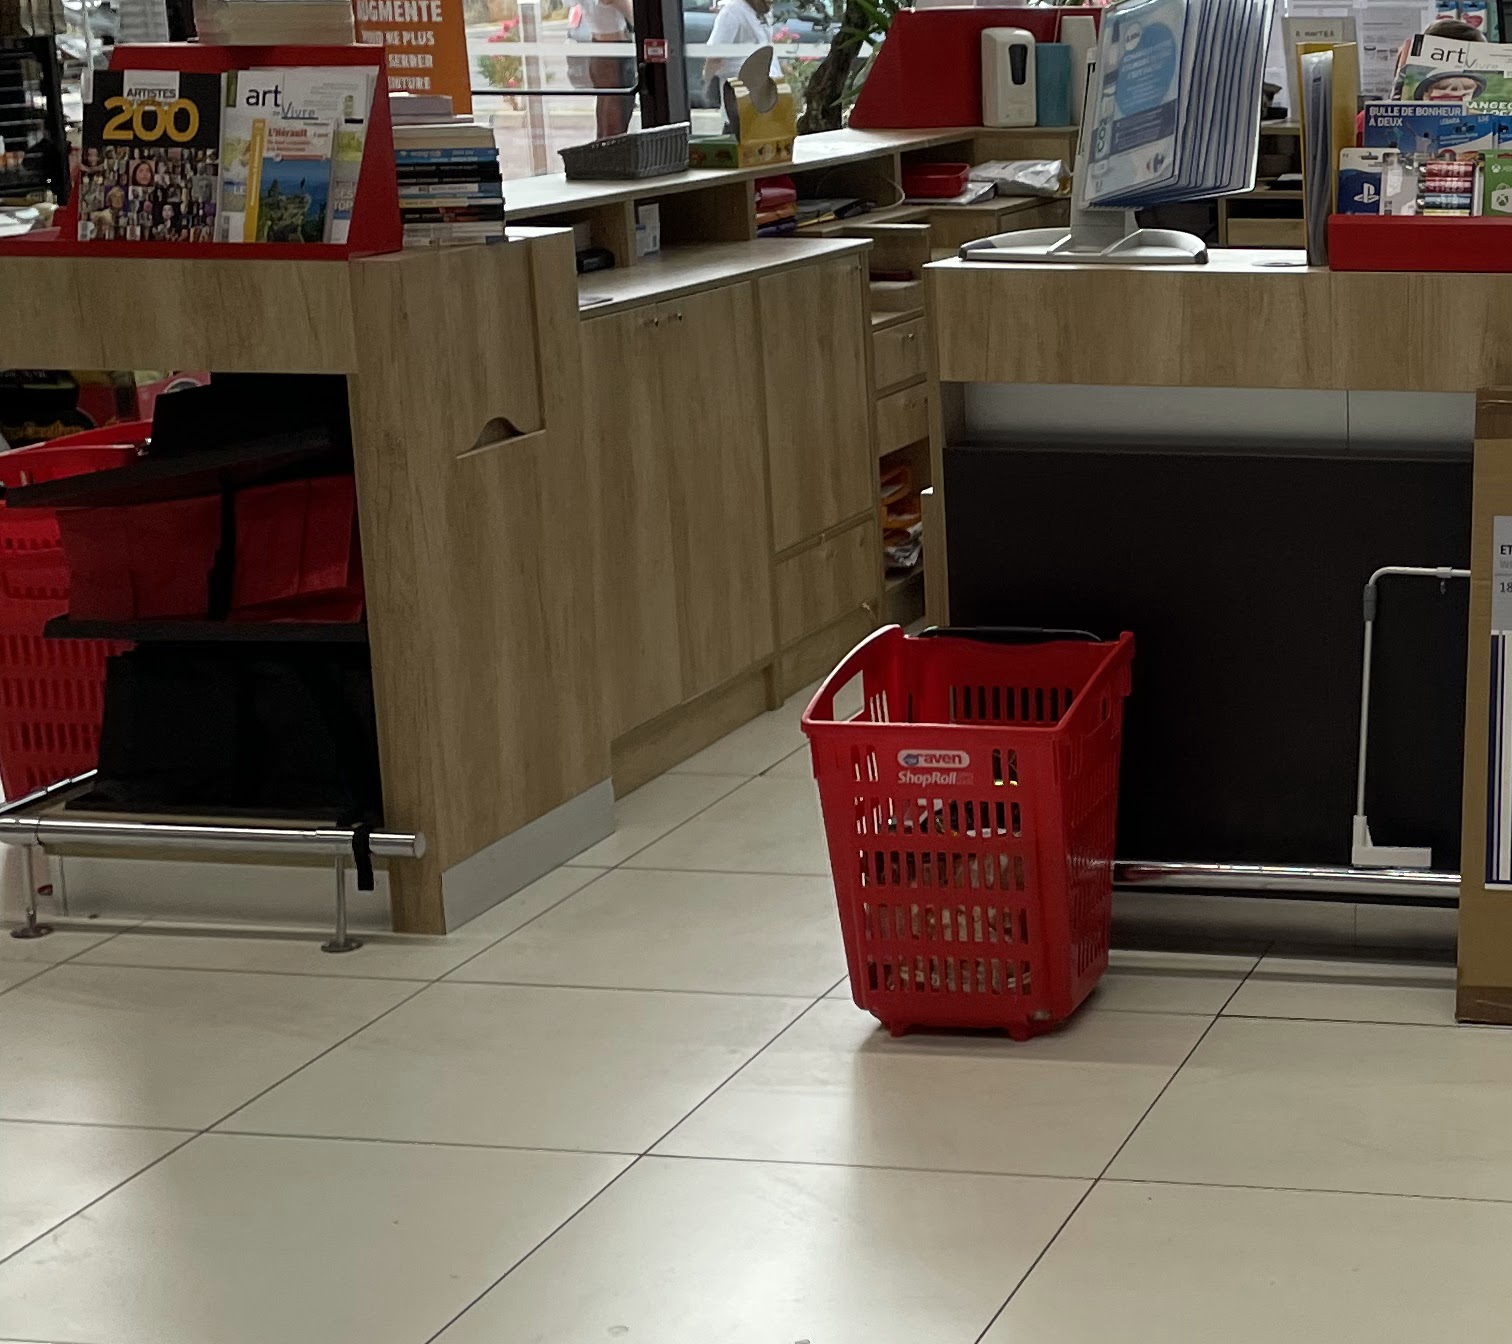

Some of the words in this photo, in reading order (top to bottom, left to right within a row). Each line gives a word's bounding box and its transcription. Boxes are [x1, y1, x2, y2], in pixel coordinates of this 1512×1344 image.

[402, 30, 435, 46] PLUS
[1430, 47, 1467, 64] art
[127, 88, 177, 99] ARTISTES
[245, 85, 282, 107] art
[282, 102, 317, 119] Vivre
[1369, 107, 1400, 116] BULLE
[1401, 107, 1414, 116] DE
[1415, 107, 1462, 117] BONHEUR
[103, 96, 200, 143] 200
[1377, 117, 1403, 127] DEUX
[268, 128, 308, 138] L'Hérault
[898, 770, 957, 788] ShopRoll
